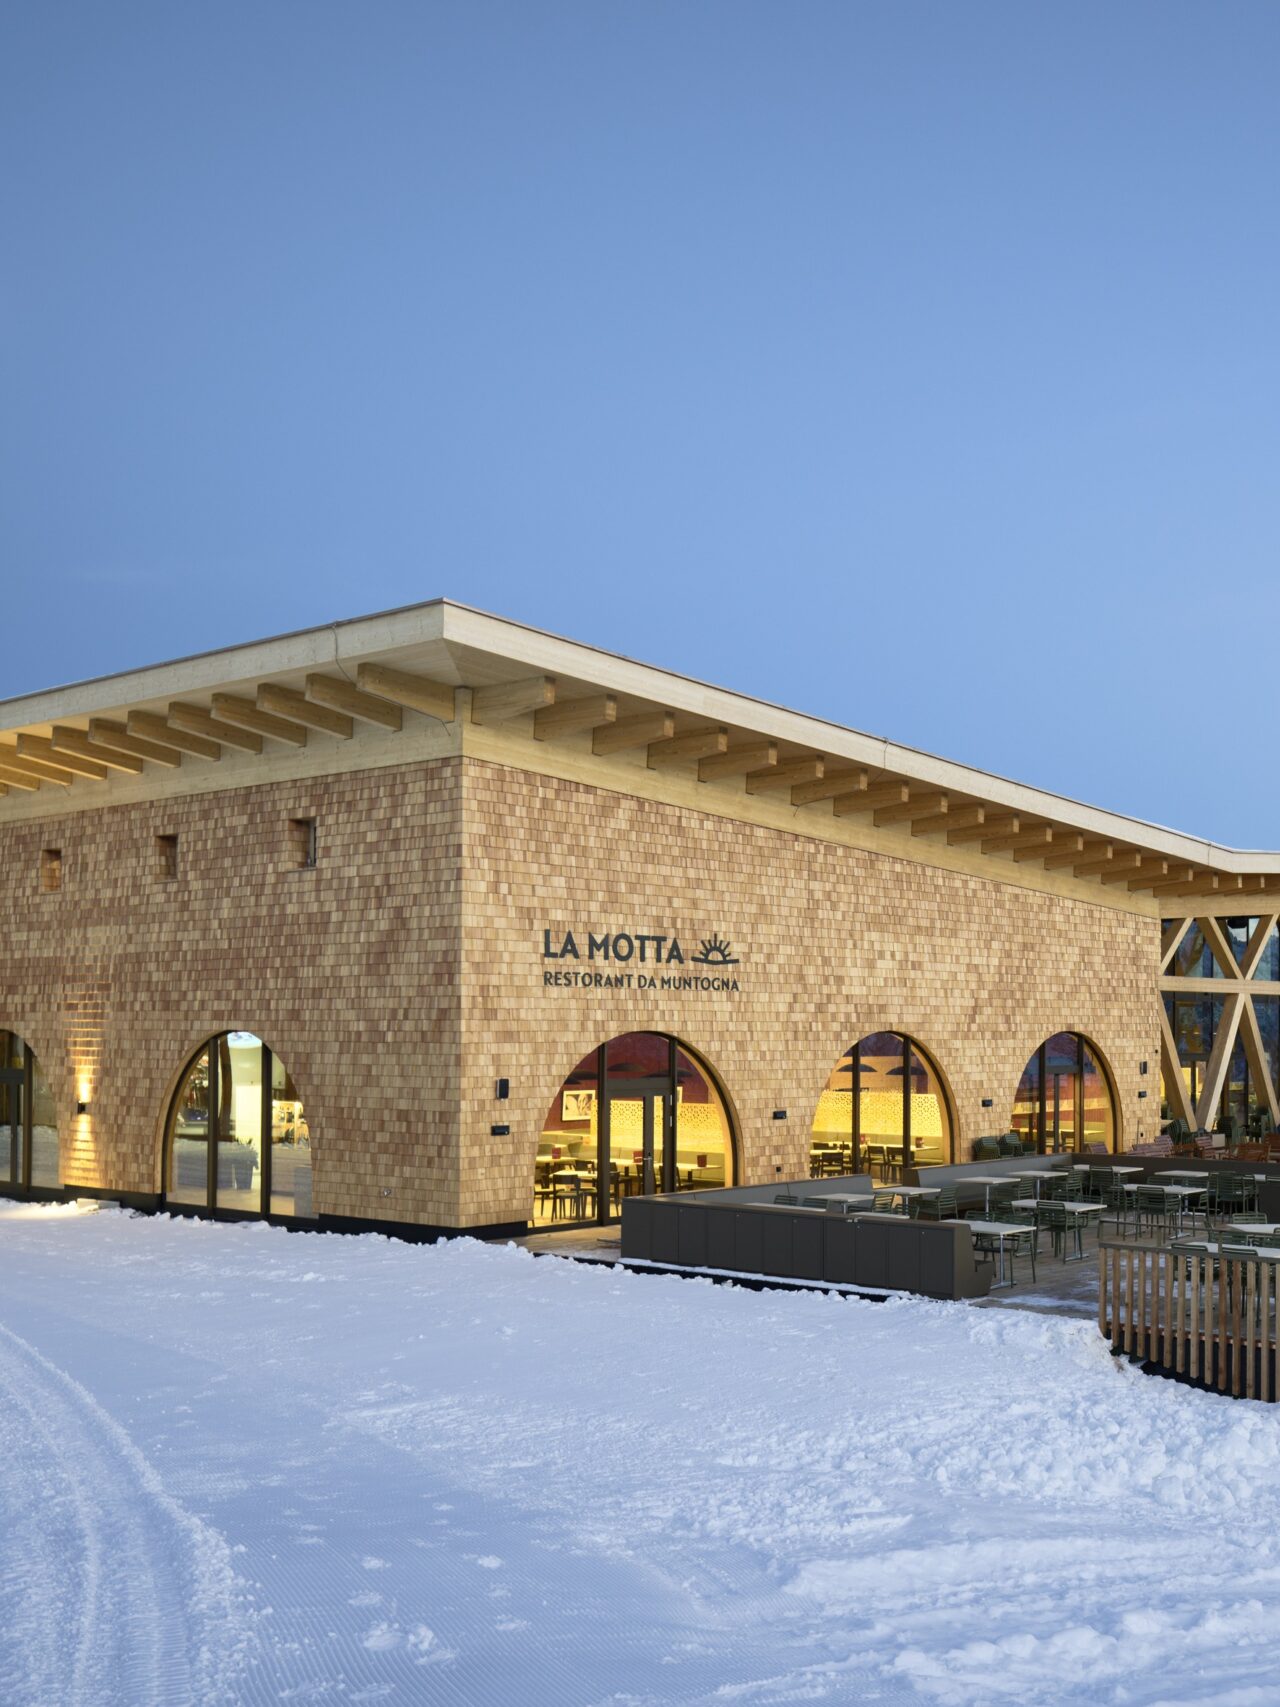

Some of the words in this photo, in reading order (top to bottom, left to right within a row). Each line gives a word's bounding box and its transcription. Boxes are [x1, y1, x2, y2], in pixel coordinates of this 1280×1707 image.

[544, 929, 579, 959] LA
[588, 931, 684, 964] MOTTA
[543, 971, 633, 988] RESTORANT
[638, 974, 656, 989] DA
[661, 976, 739, 992] MUNTOGNA
